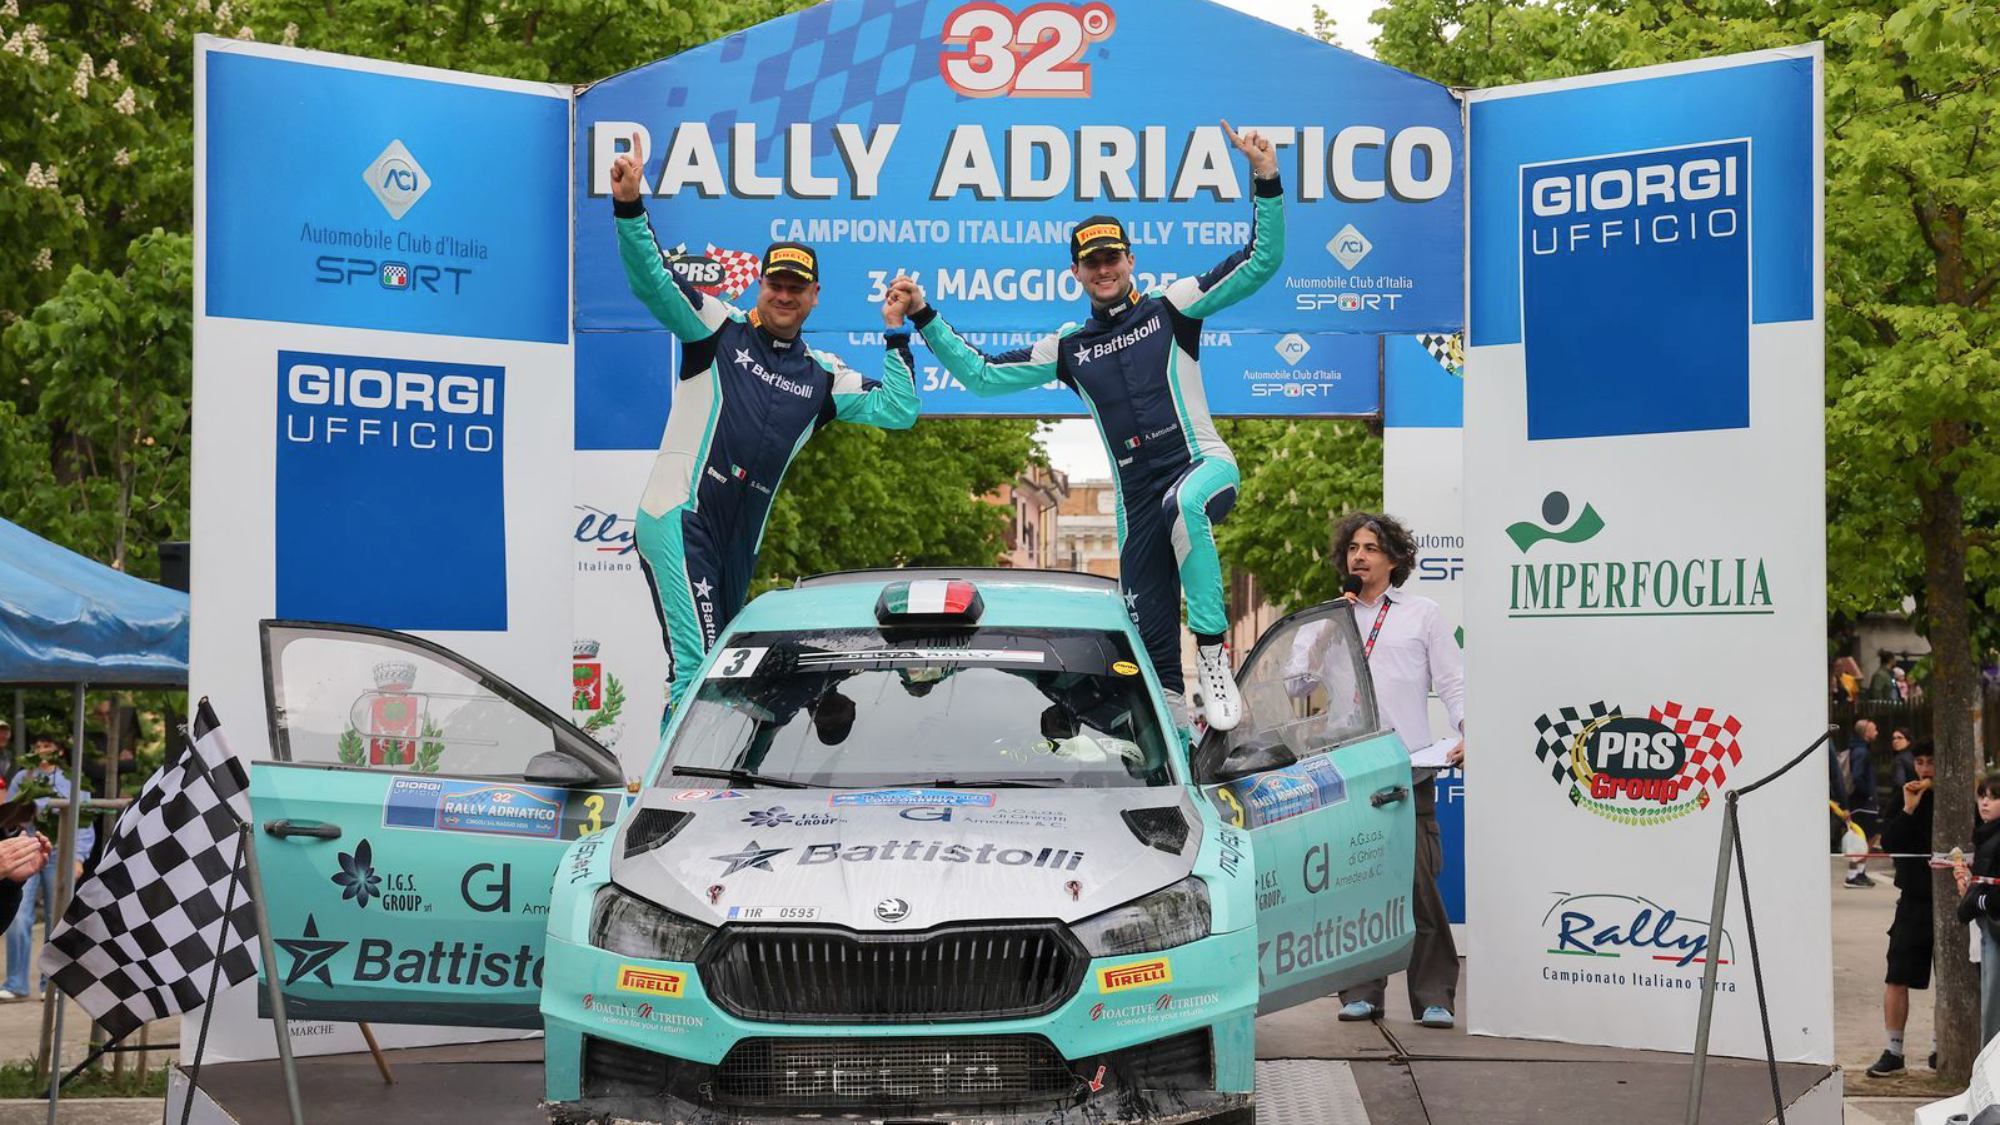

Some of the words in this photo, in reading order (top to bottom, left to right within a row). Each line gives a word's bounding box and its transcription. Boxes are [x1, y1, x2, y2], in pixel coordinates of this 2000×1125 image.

[589, 121, 901, 199] RALLY
[383, 168, 418, 191] ACI
[1532, 156, 1737, 217] GIORGI
[300, 222, 392, 250] Automobile
[397, 231, 431, 254] Club
[435, 235, 488, 260] d'Italia
[770, 218, 950, 244] CAMPIONATO
[1128, 222, 1174, 245] LLY
[1182, 222, 1249, 245] TERR
[1532, 208, 1737, 255] UFFICIO
[1340, 240, 1363, 254] ACI
[316, 255, 473, 295] SPORT
[937, 268, 1084, 302] MAGGIO
[1285, 276, 1346, 289] Automobile
[1350, 276, 1374, 289] Club
[1376, 276, 1413, 289] d'Italia
[1296, 292, 1402, 311] SPORT
[1093, 315, 1161, 360] Battistolli
[751, 363, 814, 399] Battistolli
[1243, 369, 1290, 380] Automobile
[1292, 370, 1311, 380] Club
[287, 364, 494, 415] GIORGI
[1252, 382, 1334, 397] SPORT
[287, 414, 493, 453] UFFICIO
[578, 561, 632, 572] Italiano
[1508, 557, 1773, 610] IMPERFOGLIA
[722, 649, 752, 676] 3
[1596, 731, 1677, 770] PRS
[395, 780, 441, 791] GIORGI
[1590, 772, 1680, 804] Group
[444, 802, 486, 815] RALLY
[487, 807, 555, 821] ADRIATICO
[578, 795, 604, 837] 3
[1218, 787, 1244, 828] 3
[795, 818, 838, 826] GROUP
[963, 817, 1030, 826] Amedeo
[797, 840, 1084, 871] Battistolli
[387, 874, 417, 892] I.G.S.
[1261, 870, 1278, 891] I.G.S.
[382, 894, 422, 912] GROUP
[744, 908, 763, 918] 11R
[780, 908, 815, 918] 0593
[1259, 889, 1281, 911] GROUP
[1276, 895, 1406, 976] Battistolli
[1558, 908, 1709, 967] Rally
[622, 970, 680, 993] PIRELLI
[1104, 962, 1165, 989] PIRELLI
[1542, 966, 1626, 985] Campionato
[1632, 973, 1692, 989] Italiano
[290, 1024, 335, 1037] MARCHE
[1160, 1013, 1177, 1024] your
